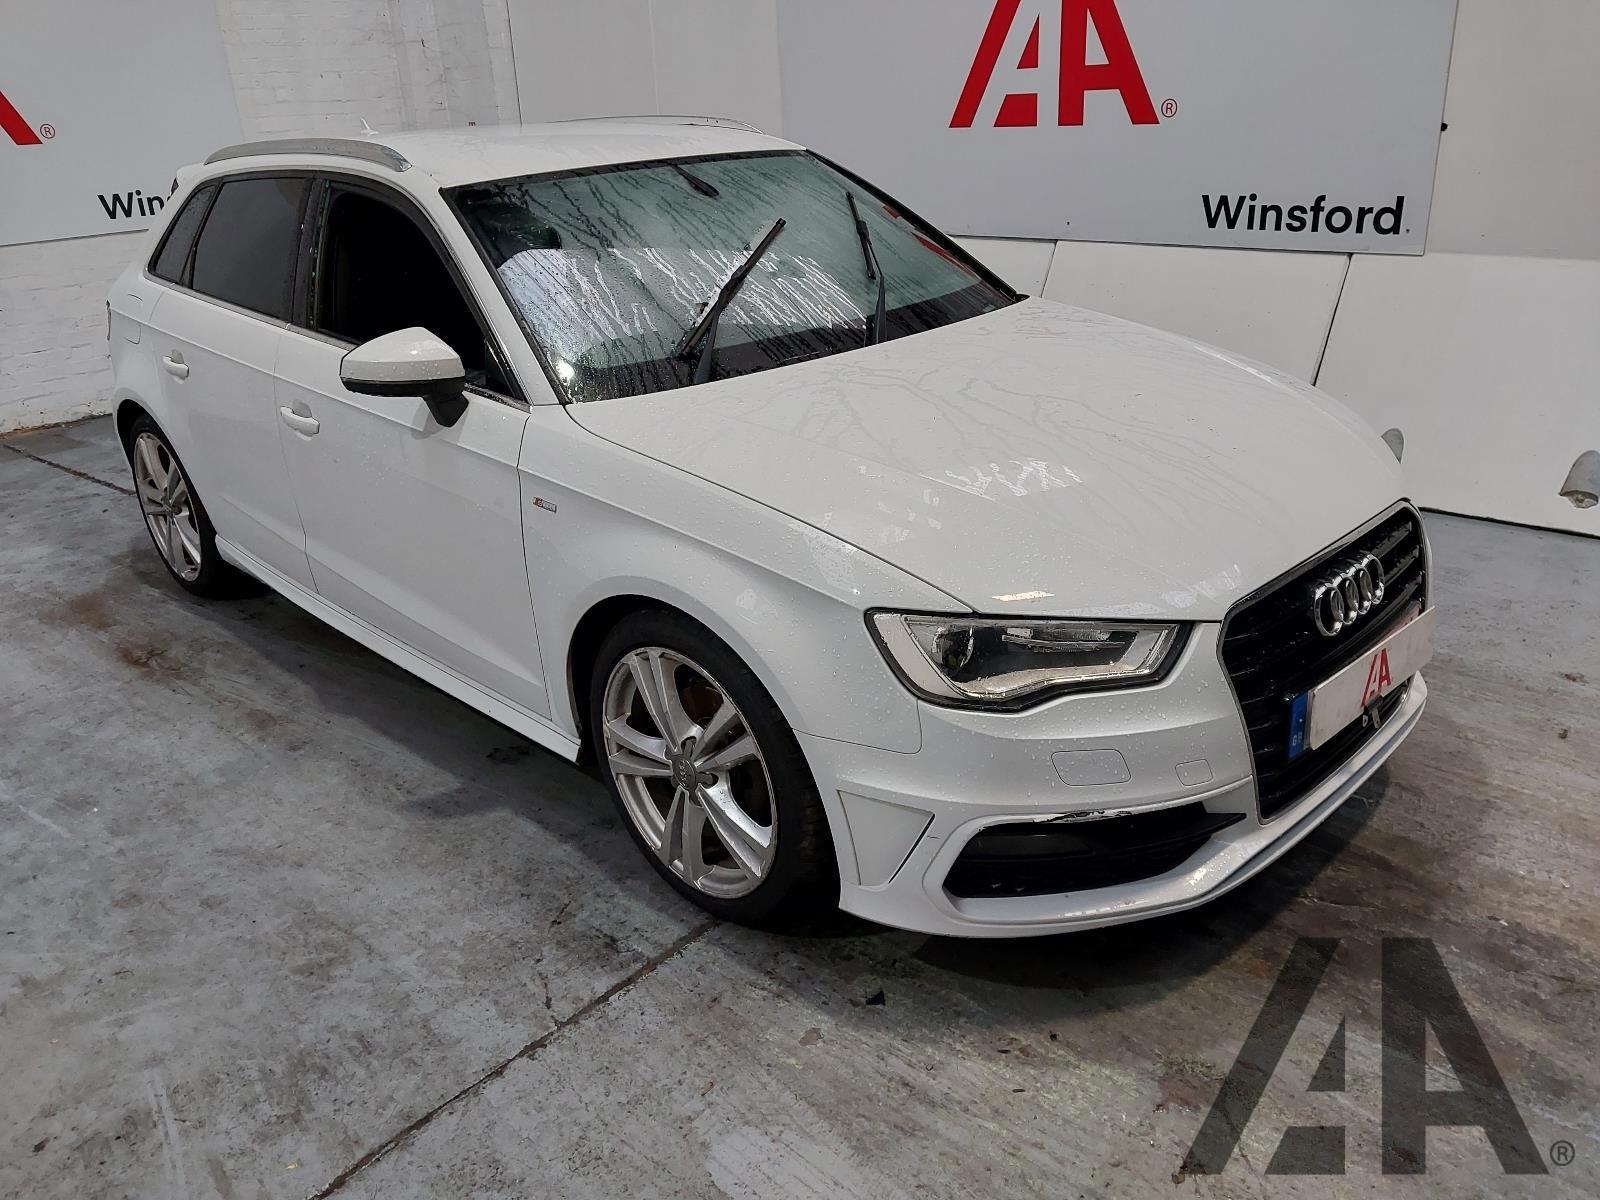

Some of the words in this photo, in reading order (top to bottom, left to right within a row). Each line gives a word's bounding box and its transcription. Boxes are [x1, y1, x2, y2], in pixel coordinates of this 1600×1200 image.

[949, 0, 1161, 128] AA
[97, 189, 171, 220] Win
[1201, 193, 1405, 235] Winsford
